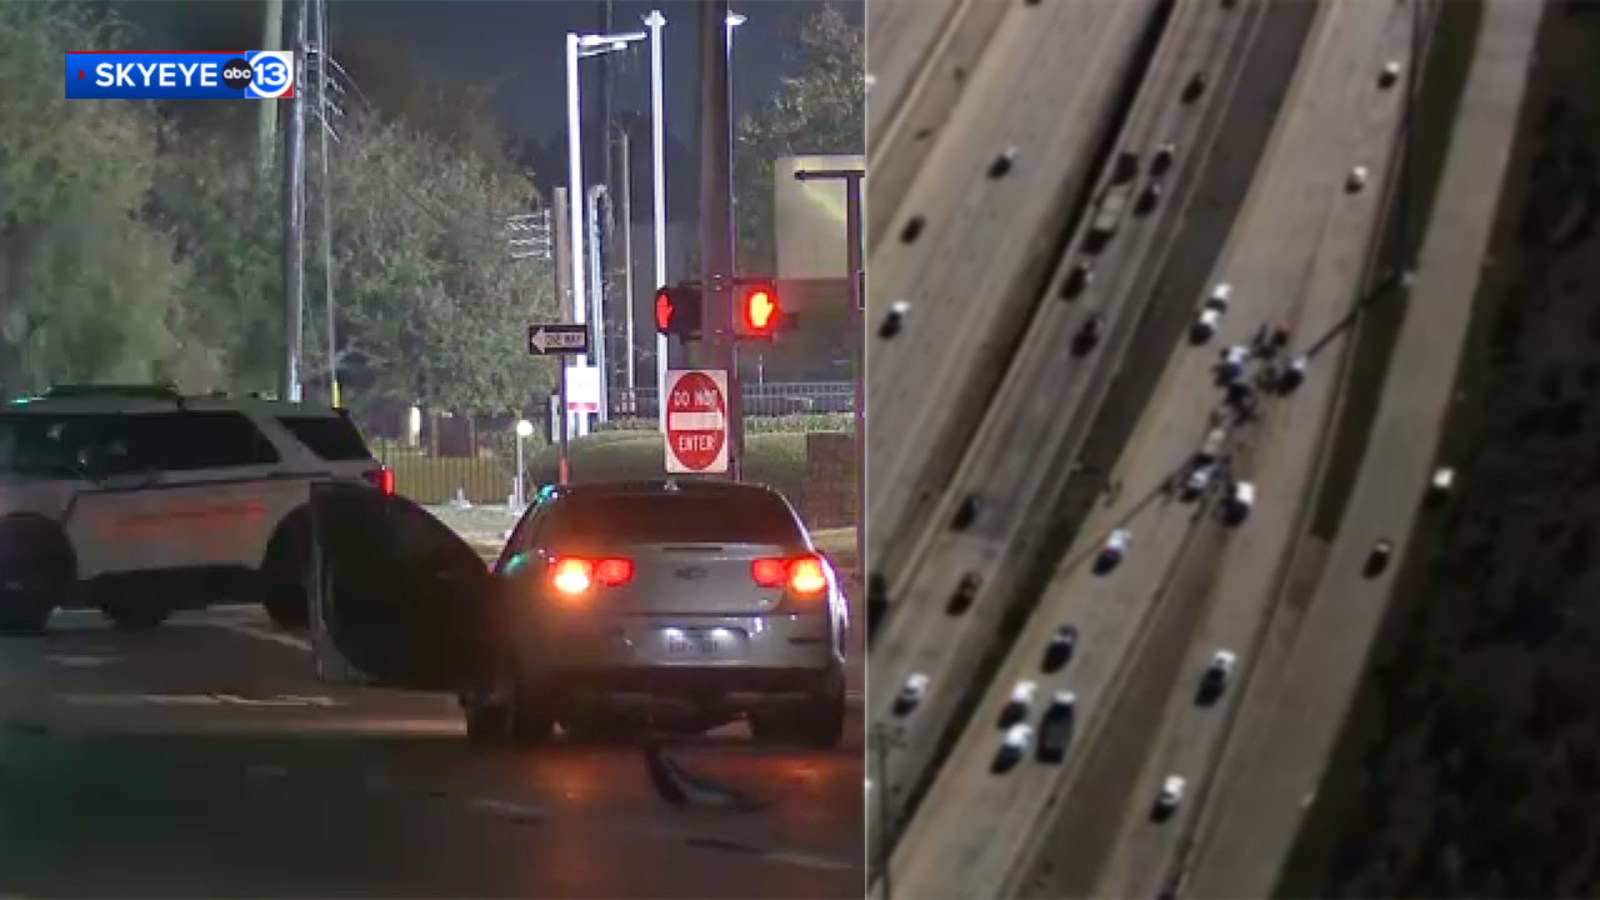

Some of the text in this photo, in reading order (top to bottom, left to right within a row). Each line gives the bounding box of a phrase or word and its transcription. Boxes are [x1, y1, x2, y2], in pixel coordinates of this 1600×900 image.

[674, 389, 718, 407] DO NOT
[679, 434, 716, 451] ENTER
